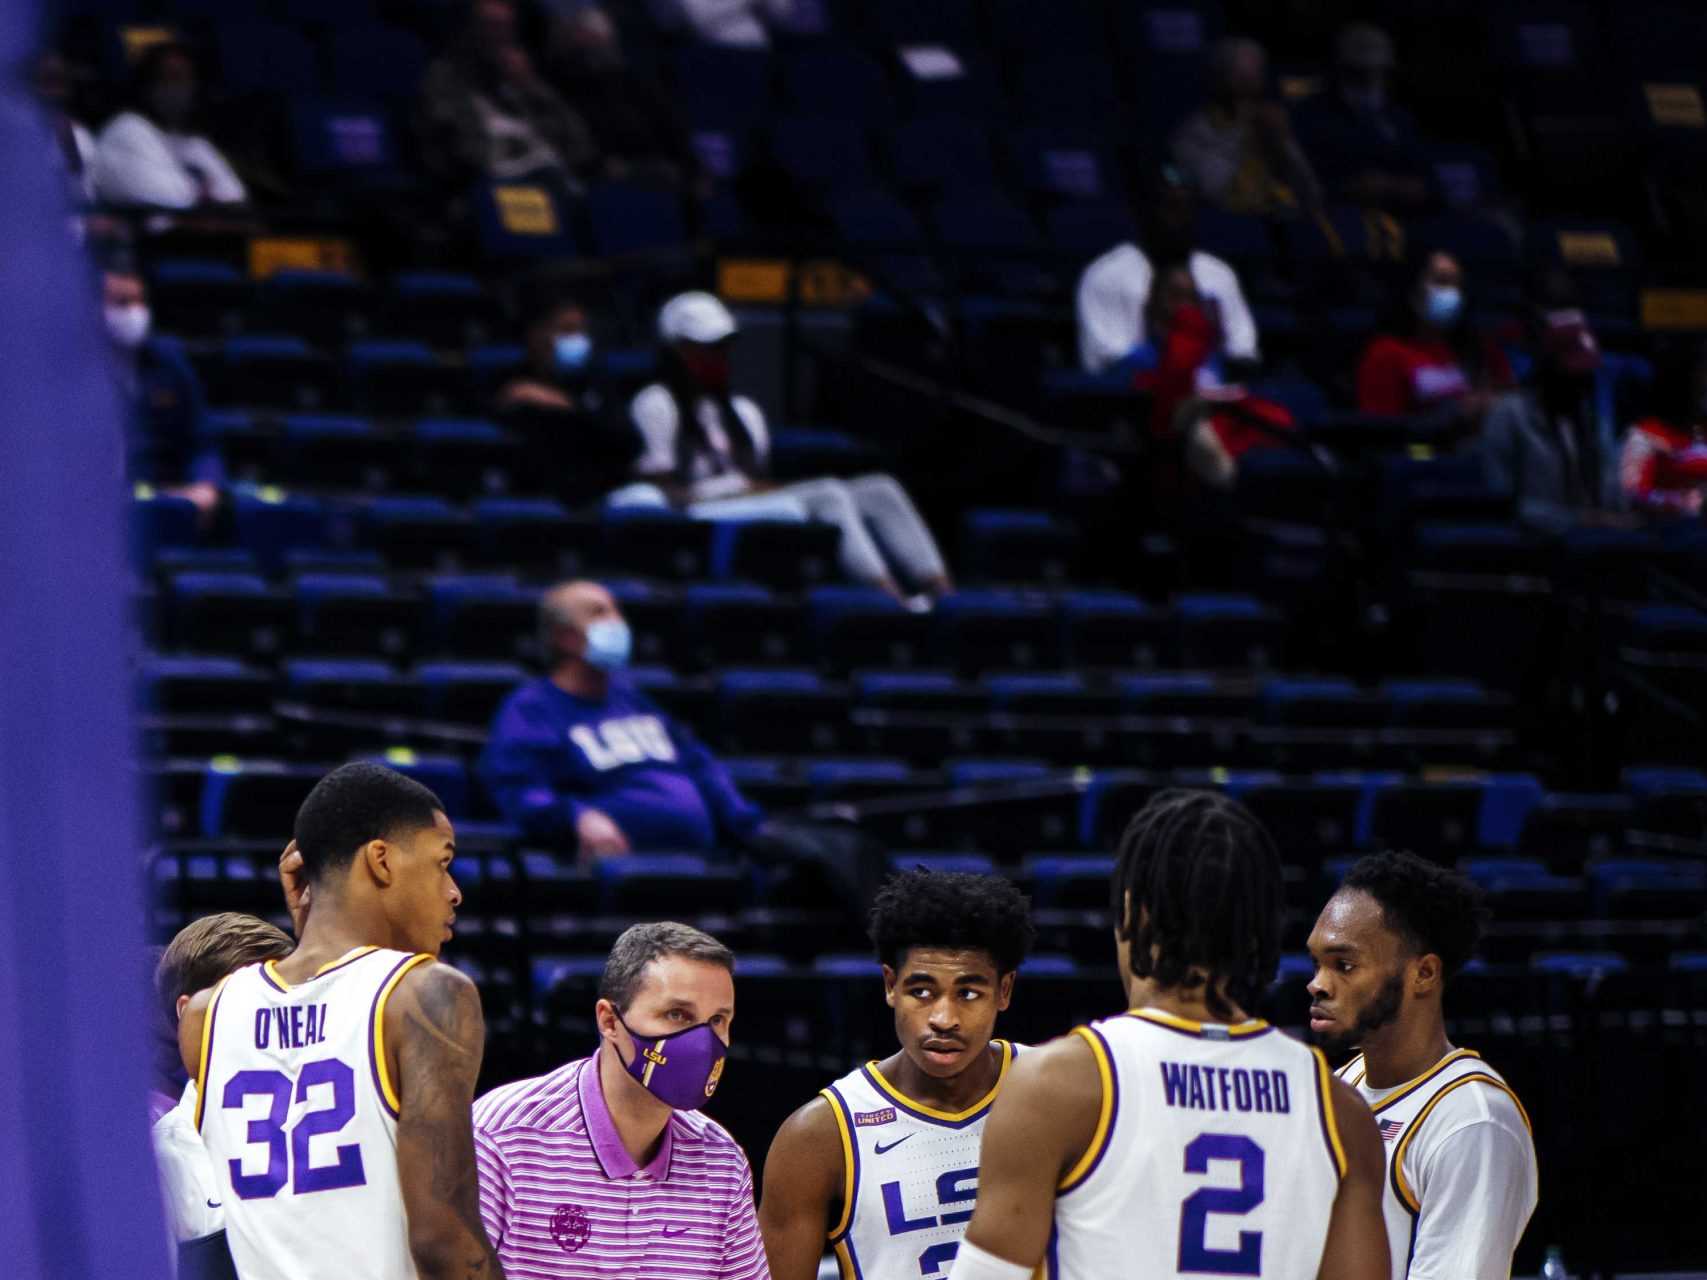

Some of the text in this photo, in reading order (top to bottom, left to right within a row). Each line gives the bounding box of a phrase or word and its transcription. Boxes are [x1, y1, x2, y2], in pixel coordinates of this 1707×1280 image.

[255, 1003, 327, 1049] O'NEAL
[643, 1047, 668, 1066] LSU
[1160, 1061, 1290, 1114] WATFORD
[222, 1058, 367, 1200] 32
[857, 1112, 894, 1125] UNITED
[881, 1167, 981, 1236] LS
[1176, 1133, 1265, 1277] 2
